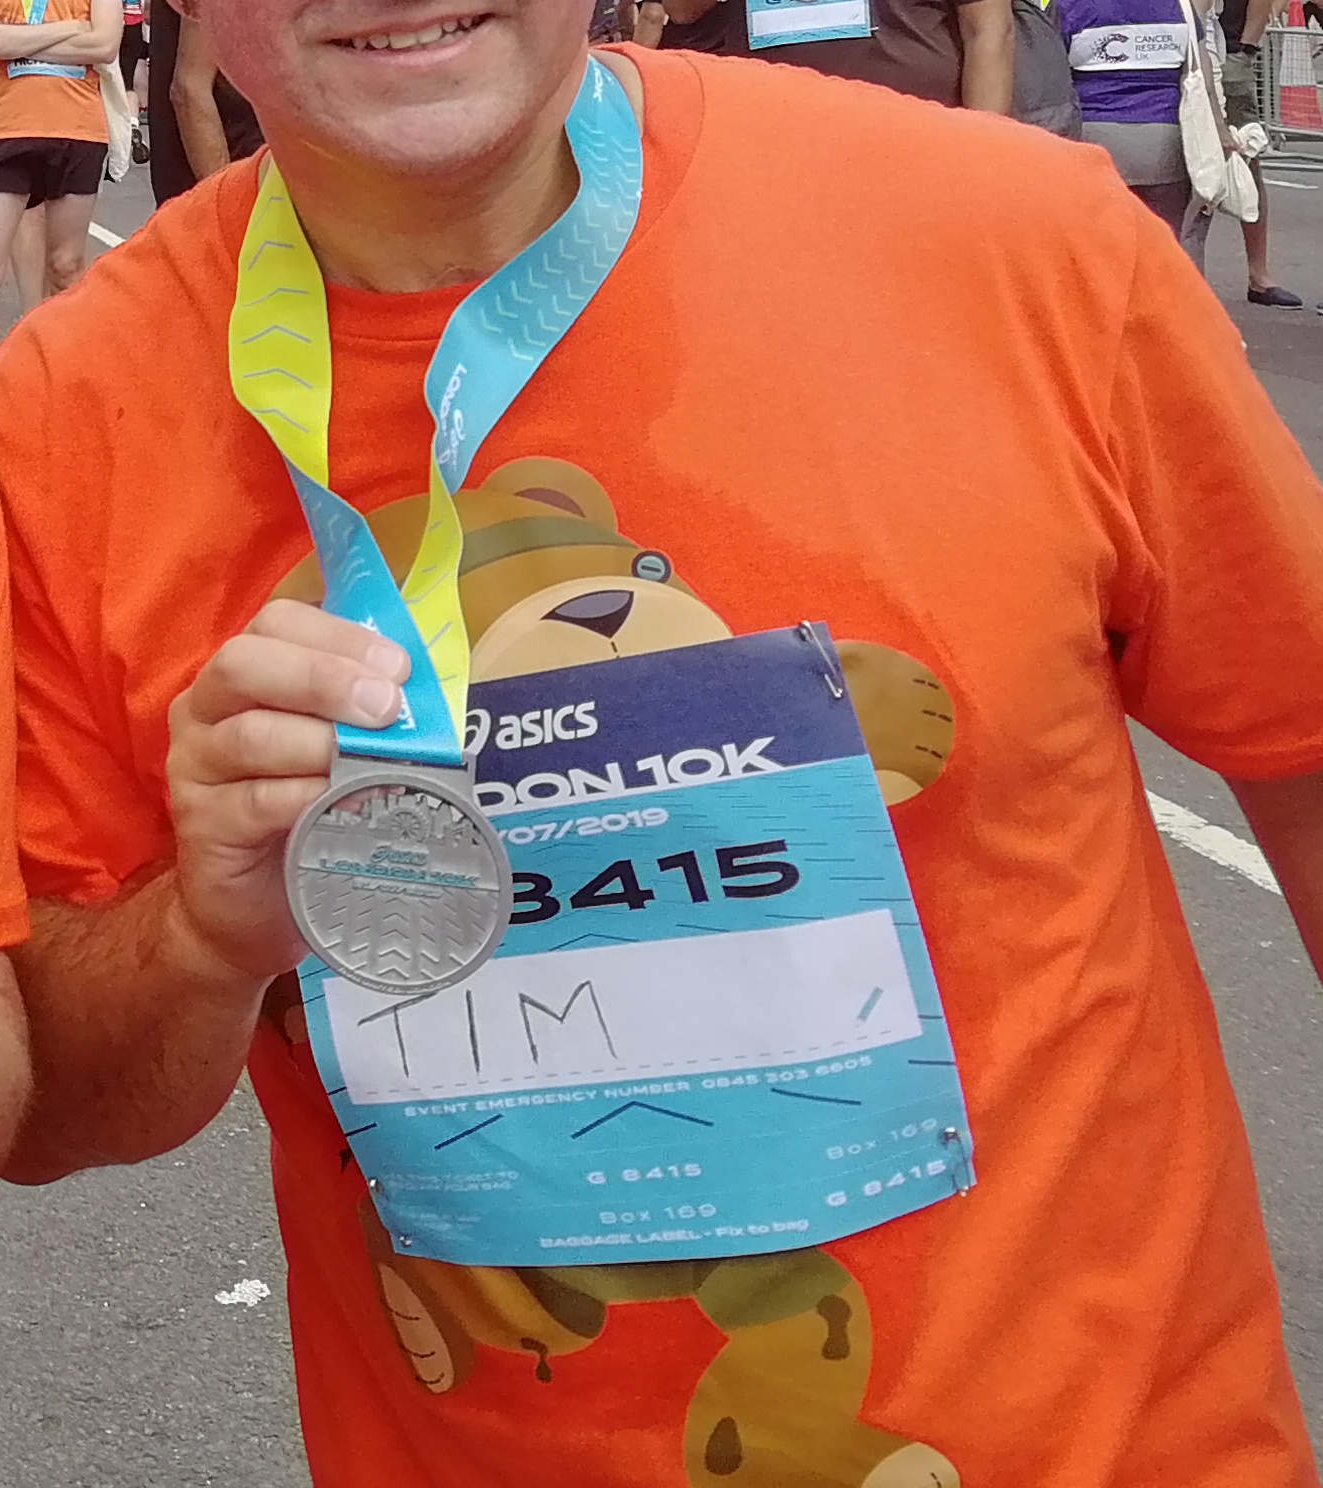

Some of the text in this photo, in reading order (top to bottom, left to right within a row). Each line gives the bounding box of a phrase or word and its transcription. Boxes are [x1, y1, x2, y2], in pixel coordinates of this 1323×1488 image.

[1135, 35, 1173, 44] CANCER
[1135, 44, 1181, 52] RESEARCH
[1135, 53, 1149, 61] UK
[495, 701, 599, 750] asics
[473, 736, 788, 810] DON 10K
[497, 807, 670, 845] /07/2019
[357, 980, 618, 1078] TIM
[405, 1102, 472, 1118] EVENT
[475, 1089, 597, 1112] EMERGENCY
[603, 1080, 690, 1100] NUMBER
[827, 1139, 877, 1161] Box
[587, 1163, 703, 1185] G 8415
[826, 1160, 947, 1209] G 8415
[540, 1233, 633, 1248] BAGGAGE
[636, 1230, 701, 1243] LABEL
[715, 1226, 743, 1238] Fix
[747, 1223, 769, 1235] to
[772, 1218, 809, 1232] bag
[599, 1211, 651, 1225] Box
